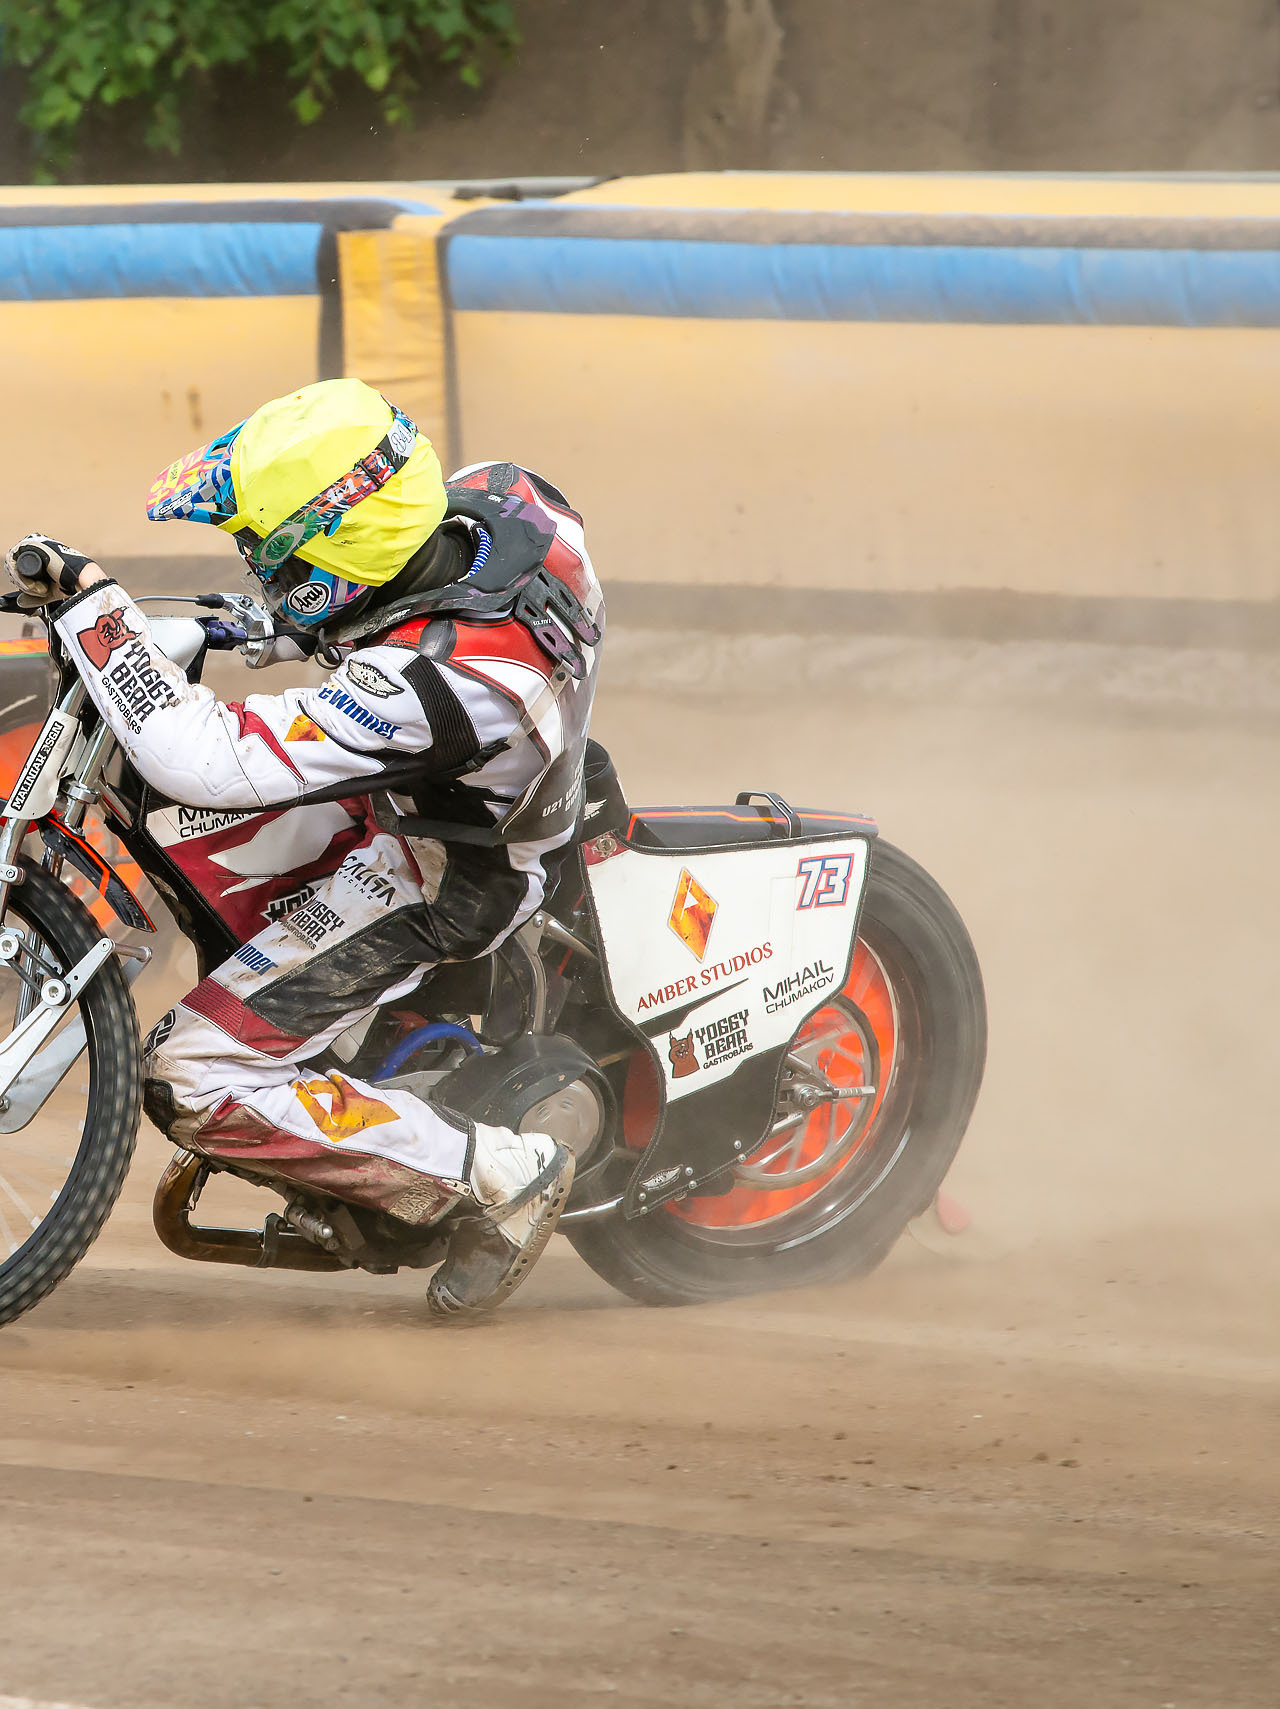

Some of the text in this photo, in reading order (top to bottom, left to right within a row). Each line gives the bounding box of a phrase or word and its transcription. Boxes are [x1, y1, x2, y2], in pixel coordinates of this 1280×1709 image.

[294, 585, 324, 613] Arai
[110, 661, 156, 723] BEAR
[124, 640, 182, 710] YOGGY
[796, 853, 855, 911] 73
[637, 942, 773, 1012] AMBER STUDIOS
[763, 959, 834, 1004] MIHAIL
[766, 973, 835, 1015] CHUMAKOV
[694, 1009, 750, 1045] YOGGY
[704, 1028, 749, 1061] BEAR
